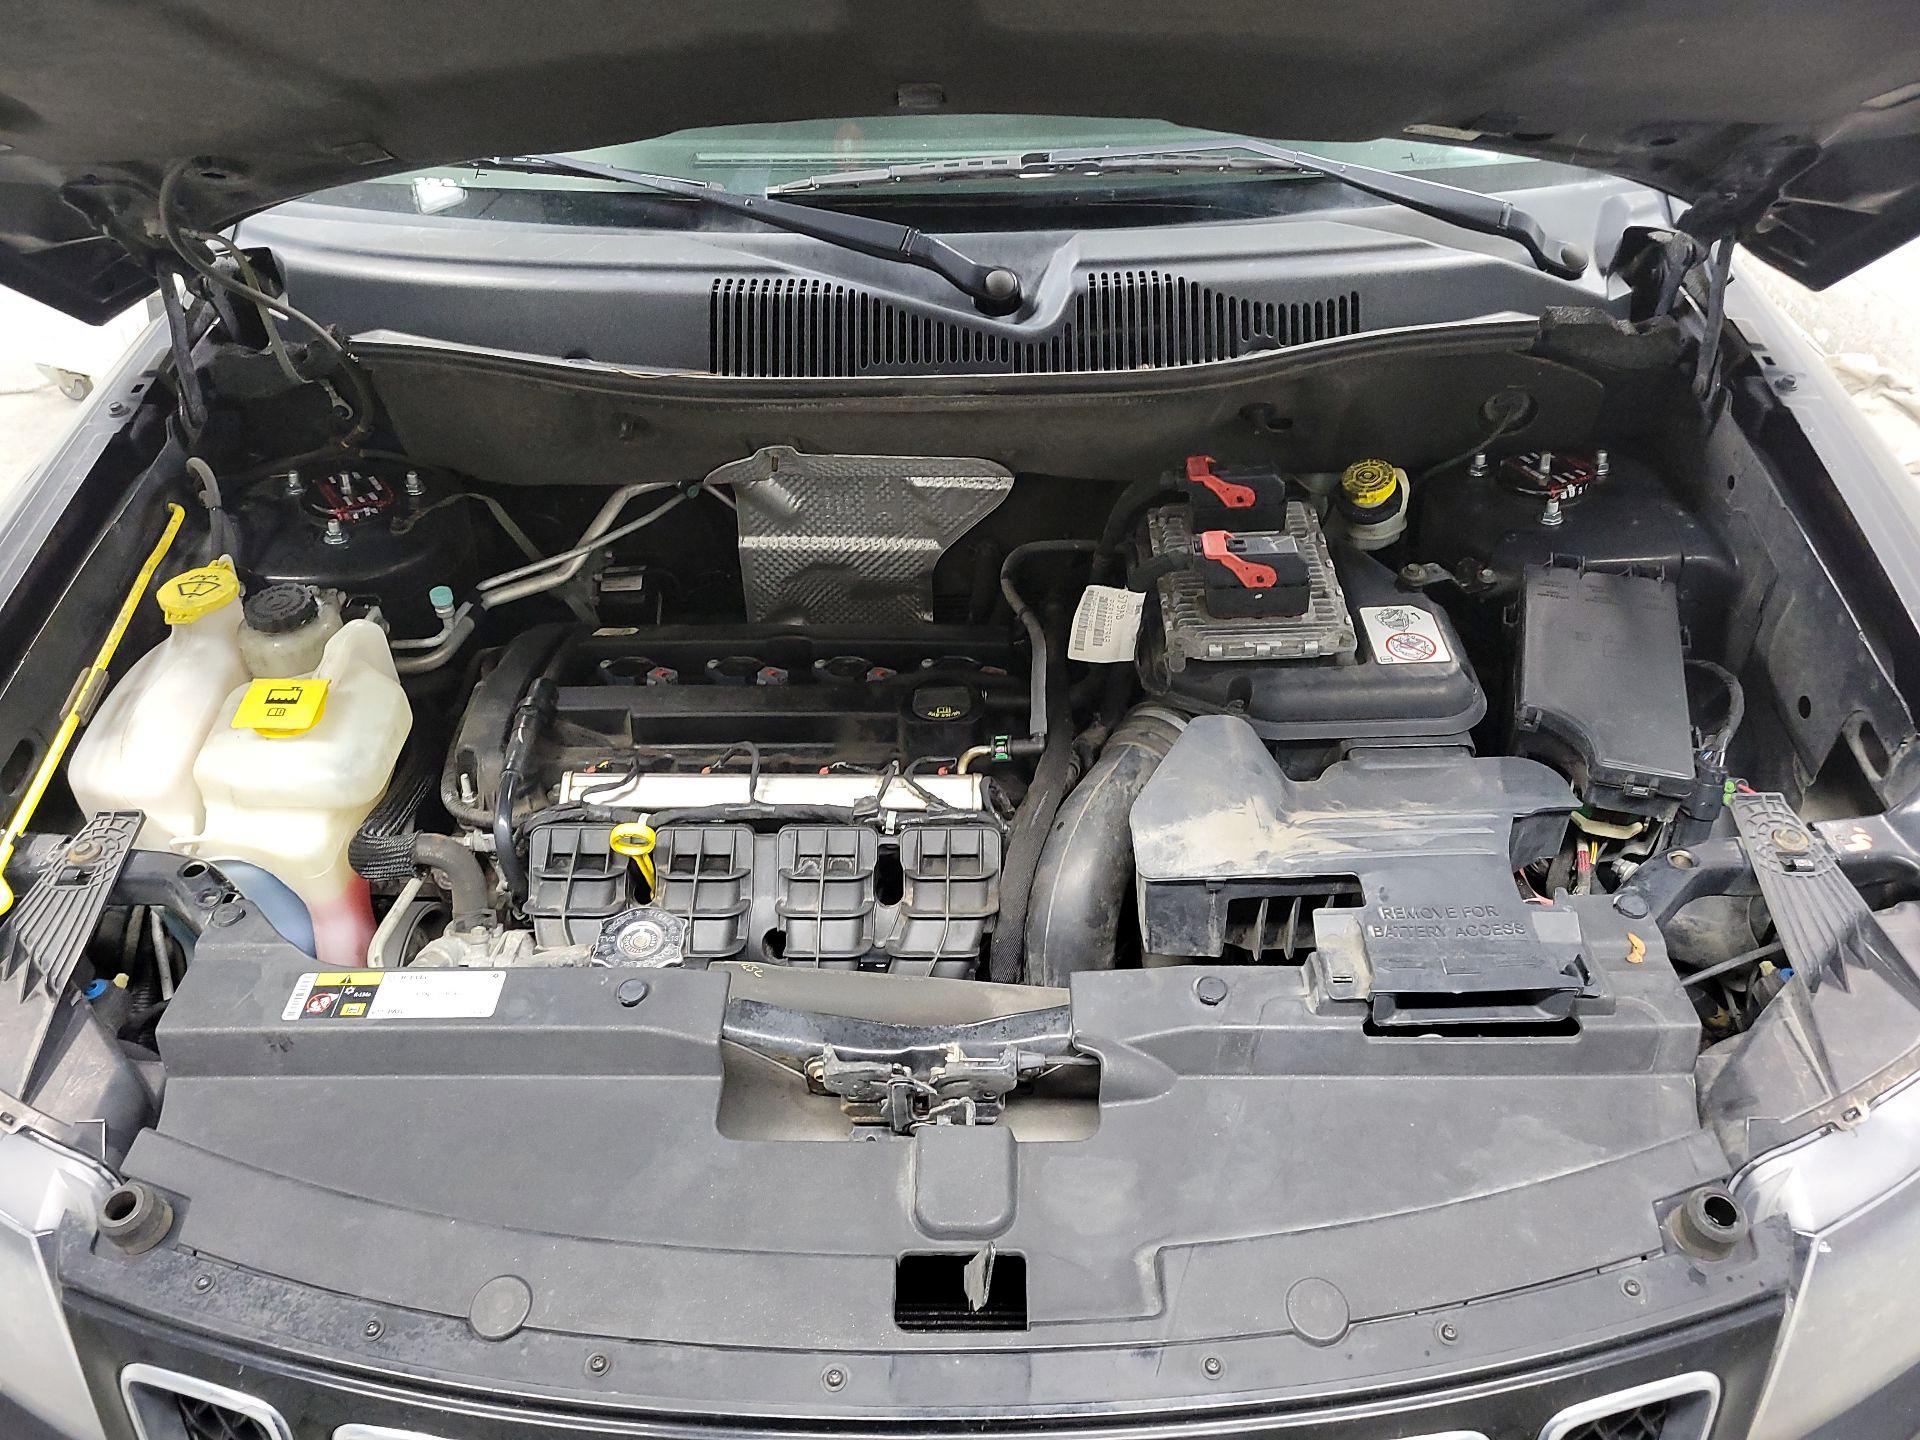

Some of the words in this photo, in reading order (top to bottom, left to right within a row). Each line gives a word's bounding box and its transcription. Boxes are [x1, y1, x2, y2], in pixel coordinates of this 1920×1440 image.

[1379, 905, 1458, 920] REMOVE
[1463, 905, 1500, 918] FOR
[1368, 924, 1448, 938] BATTERY
[1455, 923, 1527, 938] ACCESS
